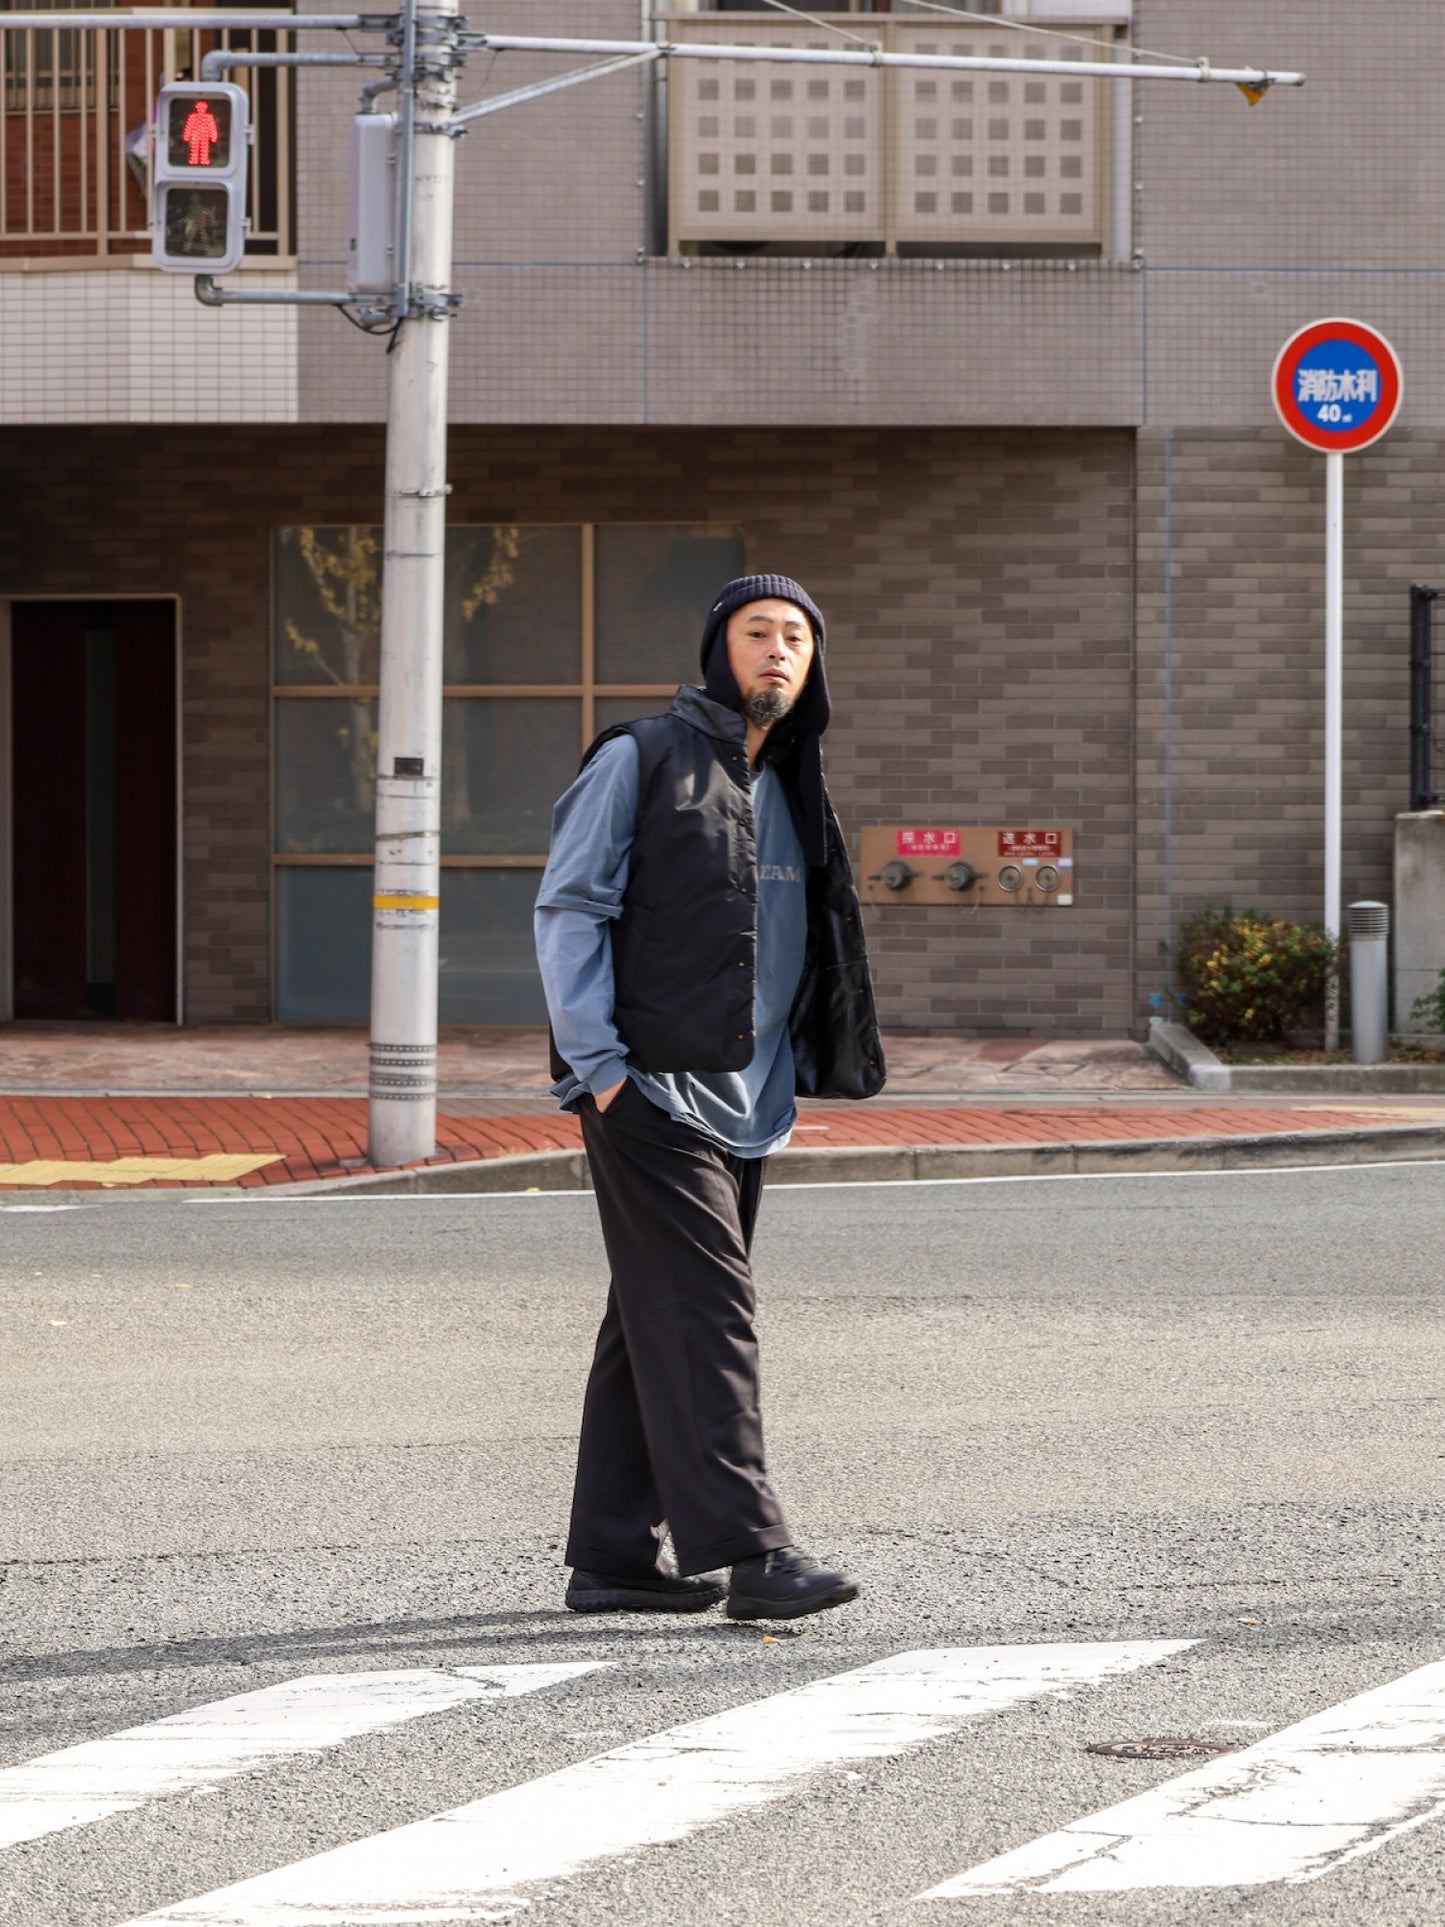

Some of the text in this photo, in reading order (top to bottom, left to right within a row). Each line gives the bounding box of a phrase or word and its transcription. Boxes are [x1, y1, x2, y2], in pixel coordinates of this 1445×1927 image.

[1297, 368, 1378, 402] 消防水利
[759, 864, 801, 882] EAM
